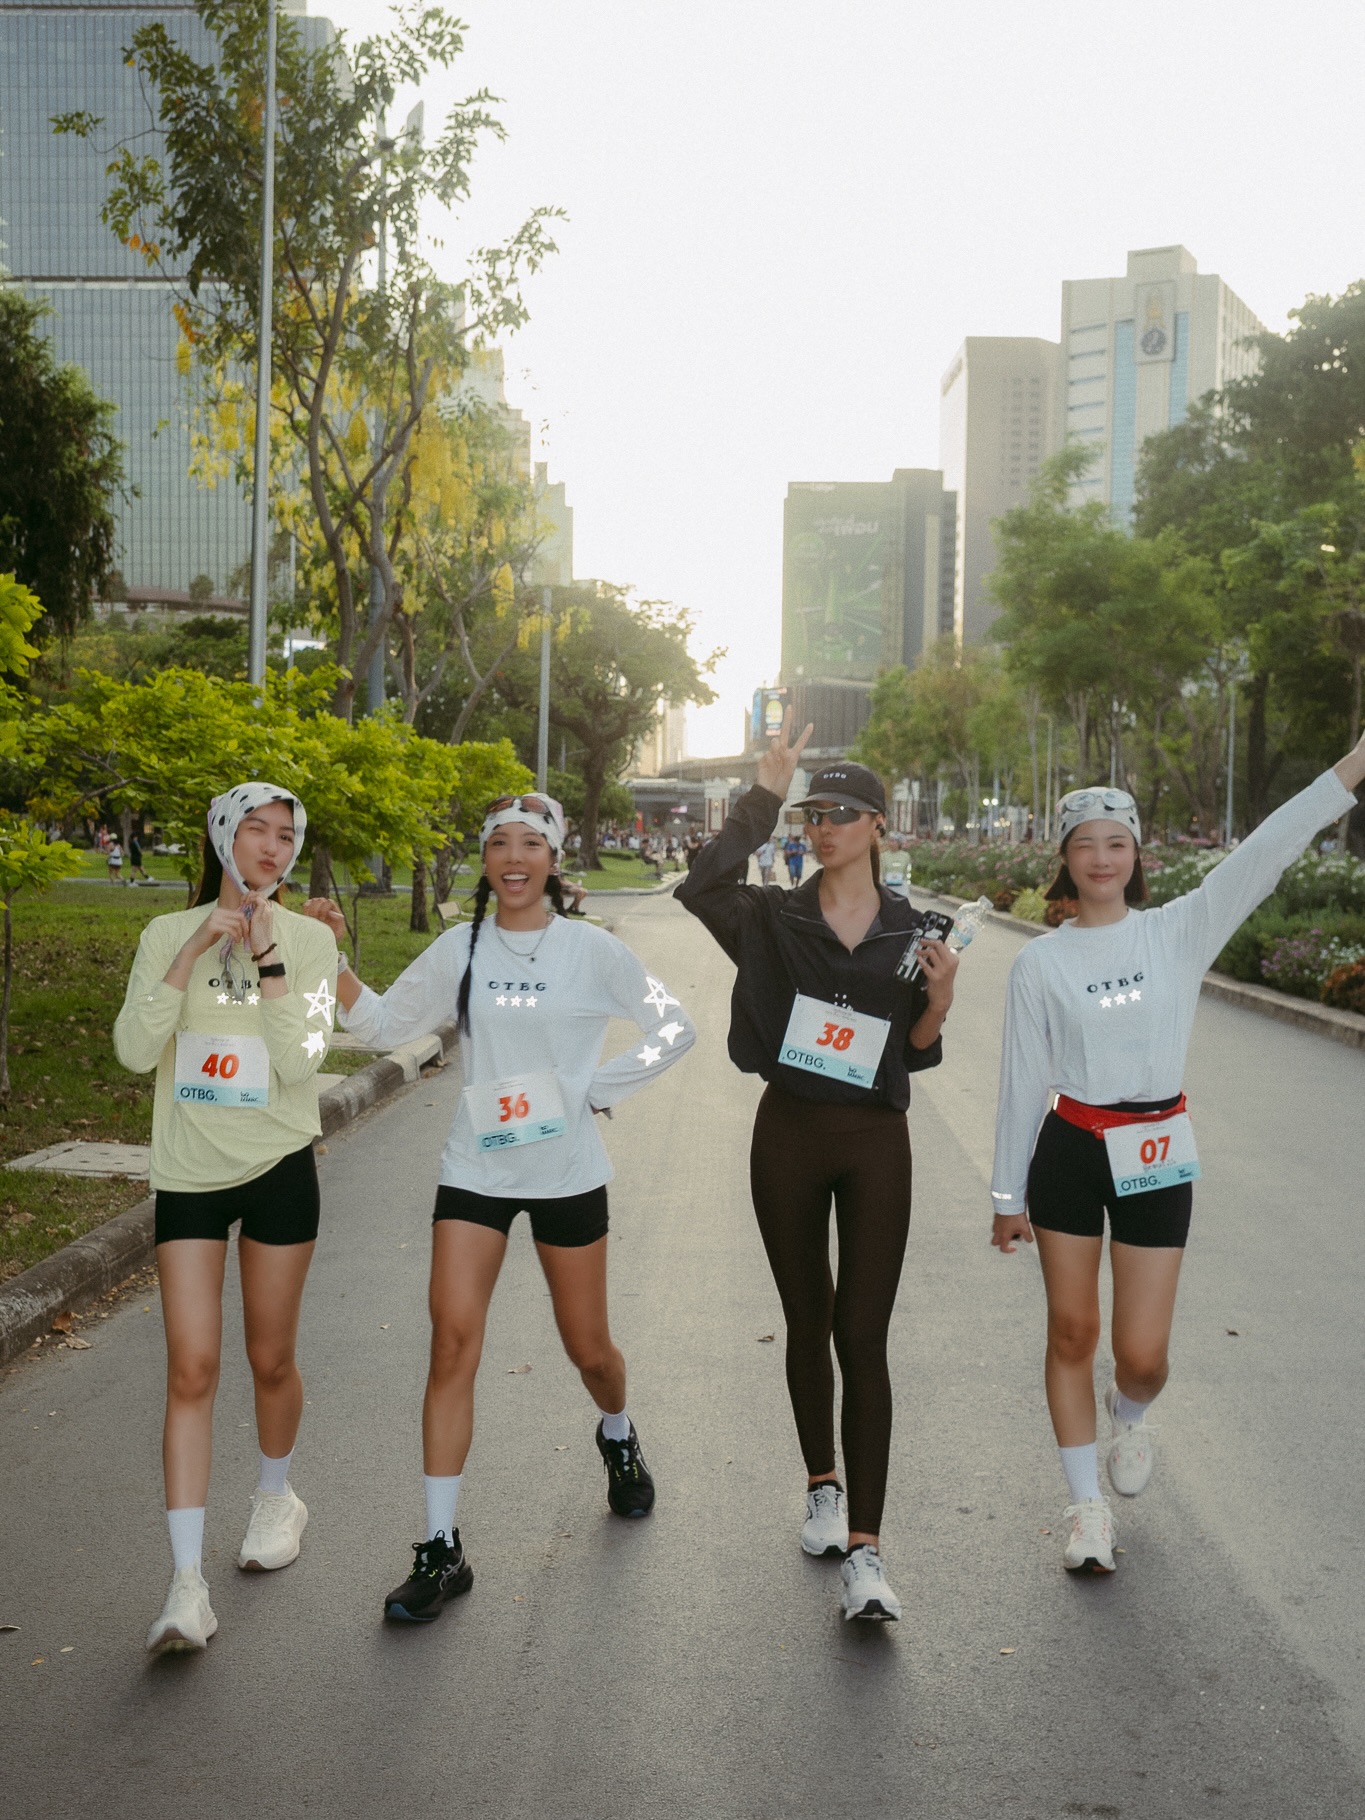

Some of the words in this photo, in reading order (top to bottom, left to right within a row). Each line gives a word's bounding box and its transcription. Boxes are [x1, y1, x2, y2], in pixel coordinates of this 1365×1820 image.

[488, 980, 547, 992] OTBG
[1086, 971, 1144, 993] OTBG
[816, 1021, 855, 1051] 38
[201, 1052, 240, 1079] 40
[498, 1092, 530, 1123] 36
[1139, 1135, 1171, 1165] 07
